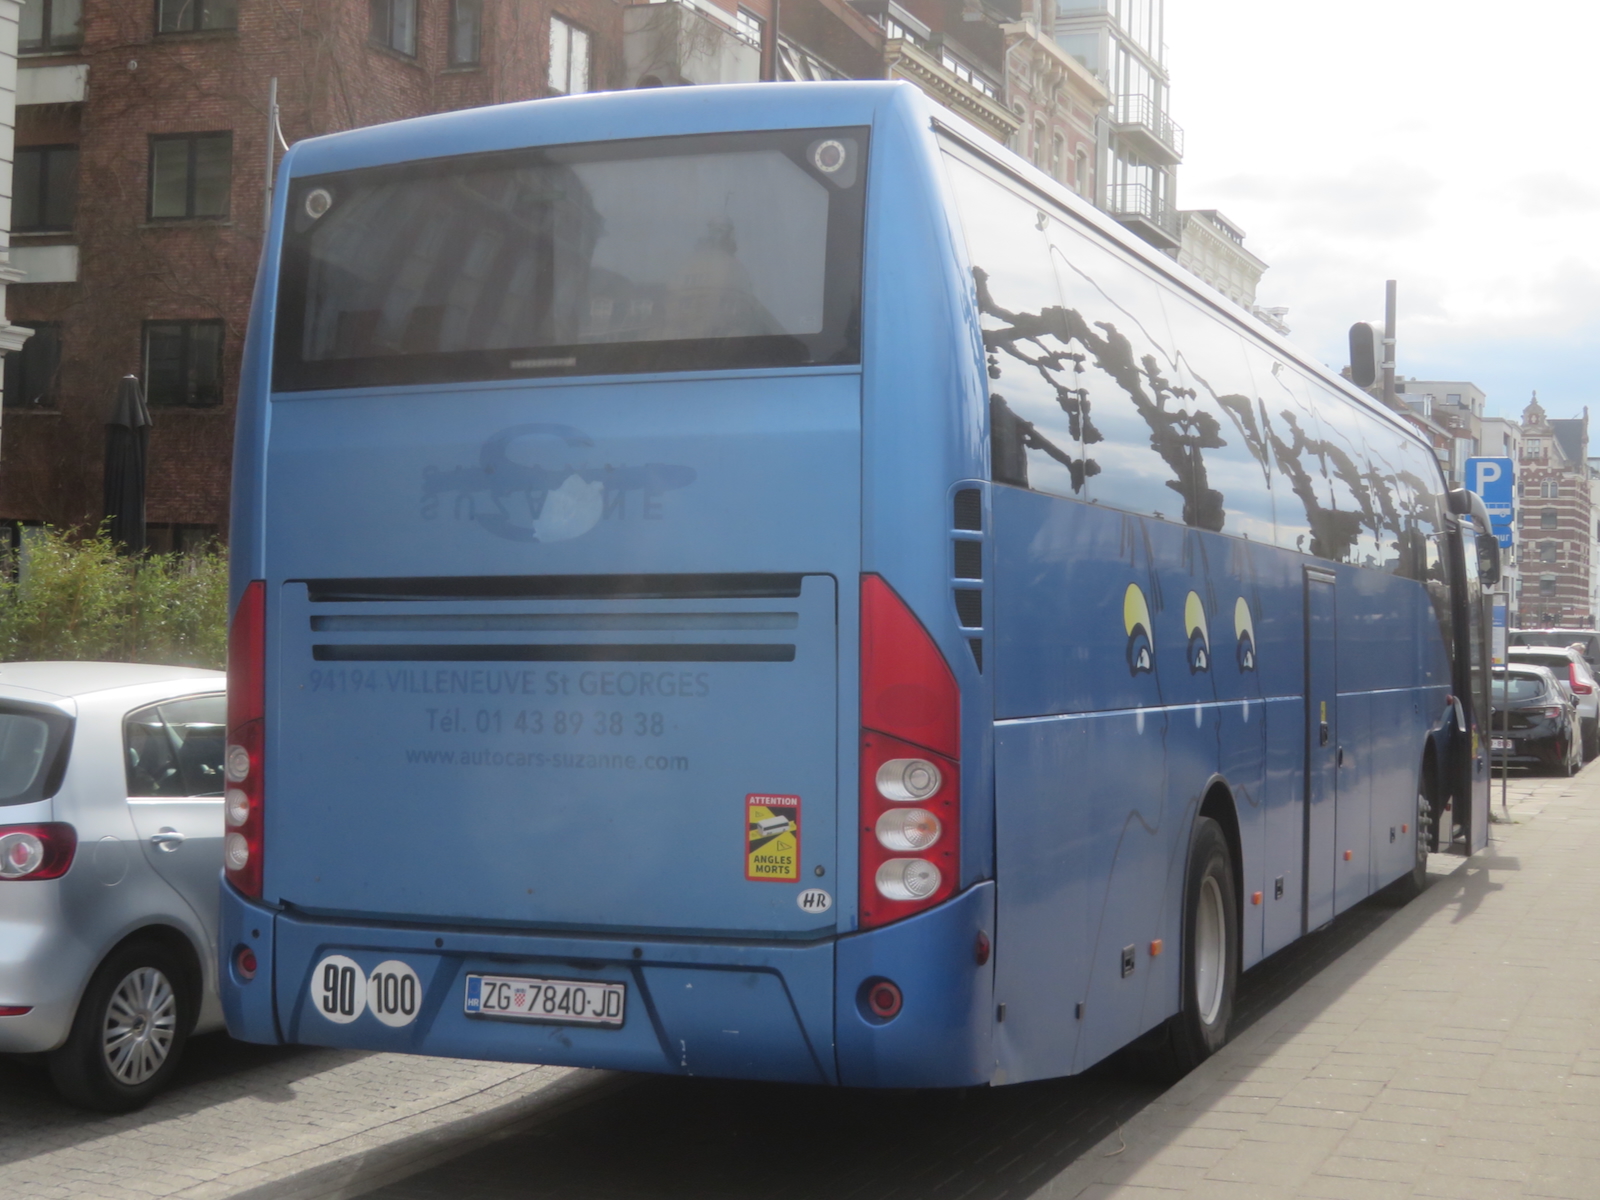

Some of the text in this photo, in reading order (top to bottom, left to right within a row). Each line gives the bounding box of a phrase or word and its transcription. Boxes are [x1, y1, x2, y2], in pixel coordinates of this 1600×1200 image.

[1476, 461, 1502, 497] P
[309, 668, 710, 697] 94194 VILLENEUVE St GEORGES
[426, 708, 665, 737] Tél. 01 43 89 38 38
[406, 748, 689, 771] www.autocars-suzanne.com
[749, 796, 797, 805] ATTENTION
[754, 855, 792, 865] ANGLES
[755, 865, 790, 874] MORTS
[803, 892, 826, 908] HR
[323, 963, 356, 1016] 90
[372, 972, 415, 1016] 100
[483, 982, 511, 1010] ZG
[468, 998, 479, 1007] HR
